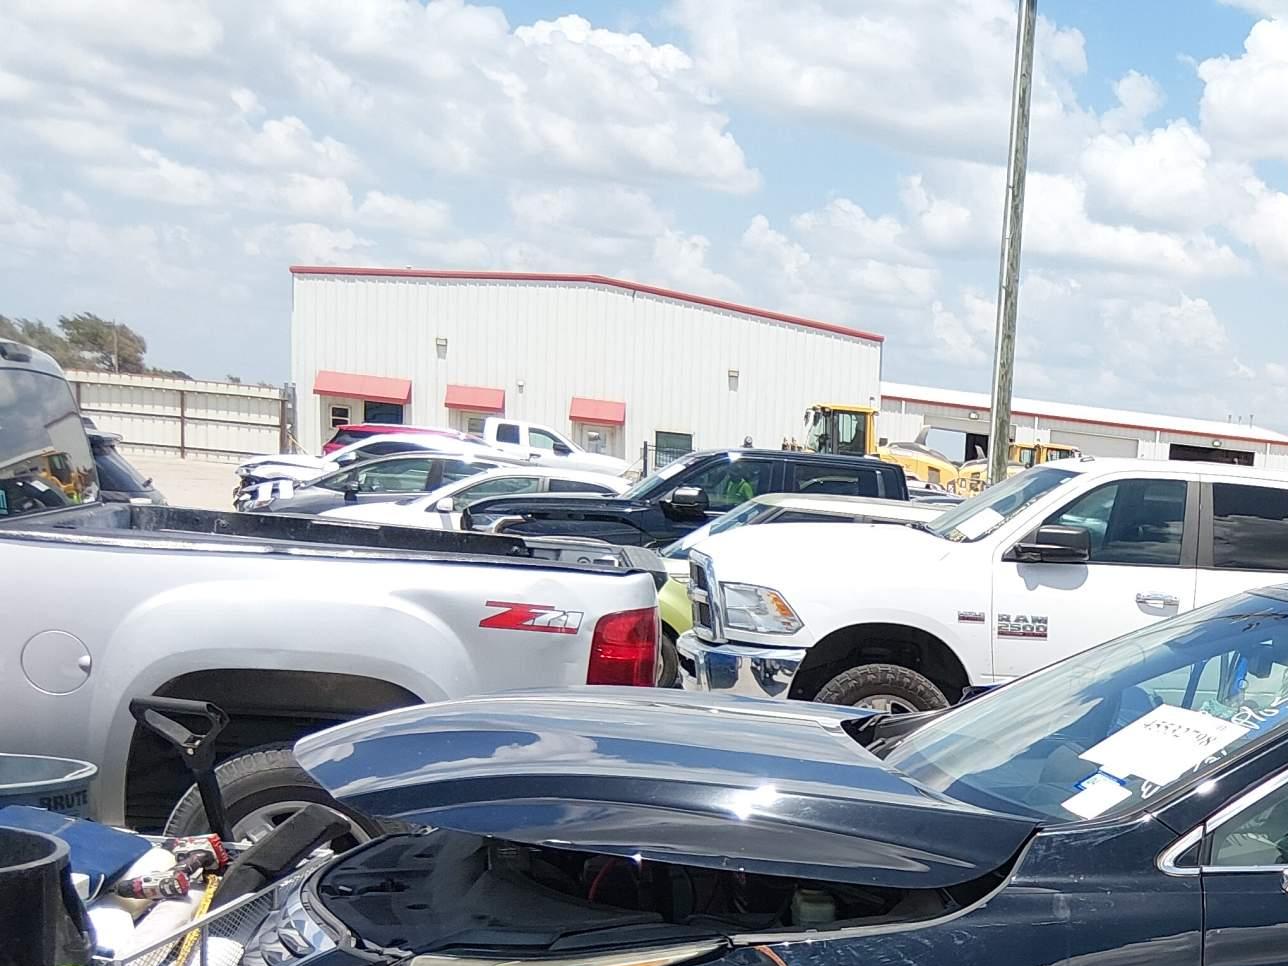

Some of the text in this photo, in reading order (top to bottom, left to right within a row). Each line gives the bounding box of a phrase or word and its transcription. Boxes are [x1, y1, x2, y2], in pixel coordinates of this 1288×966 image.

[478, 600, 584, 635] Z71
[997, 623, 1048, 633] 2500
[998, 613, 1048, 624] RAM
[1143, 719, 1218, 747] 45532798
[40, 789, 89, 811] BRUTE
